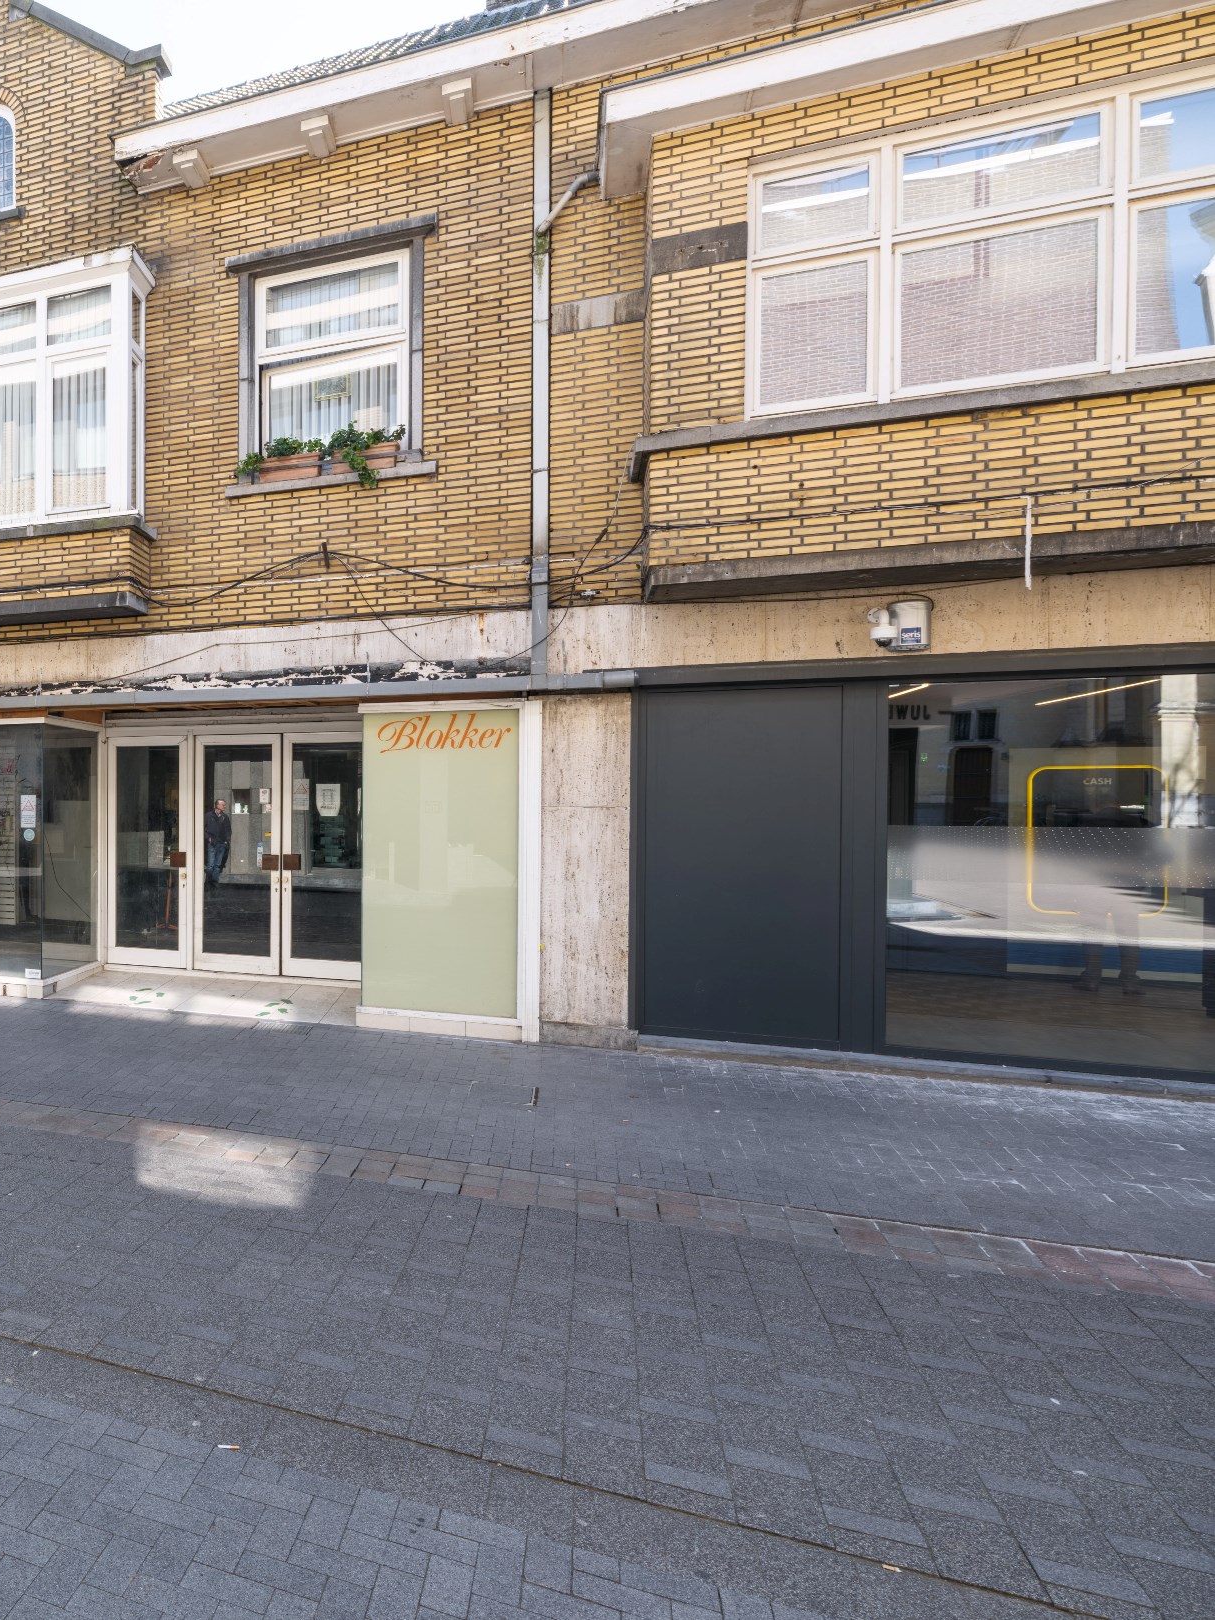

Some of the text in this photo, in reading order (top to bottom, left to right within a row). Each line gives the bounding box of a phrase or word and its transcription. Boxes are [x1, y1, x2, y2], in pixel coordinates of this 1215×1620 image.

[901, 630, 921, 640] seris
[377, 712, 512, 754] Blokker
[1082, 777, 1112, 785] CASH
